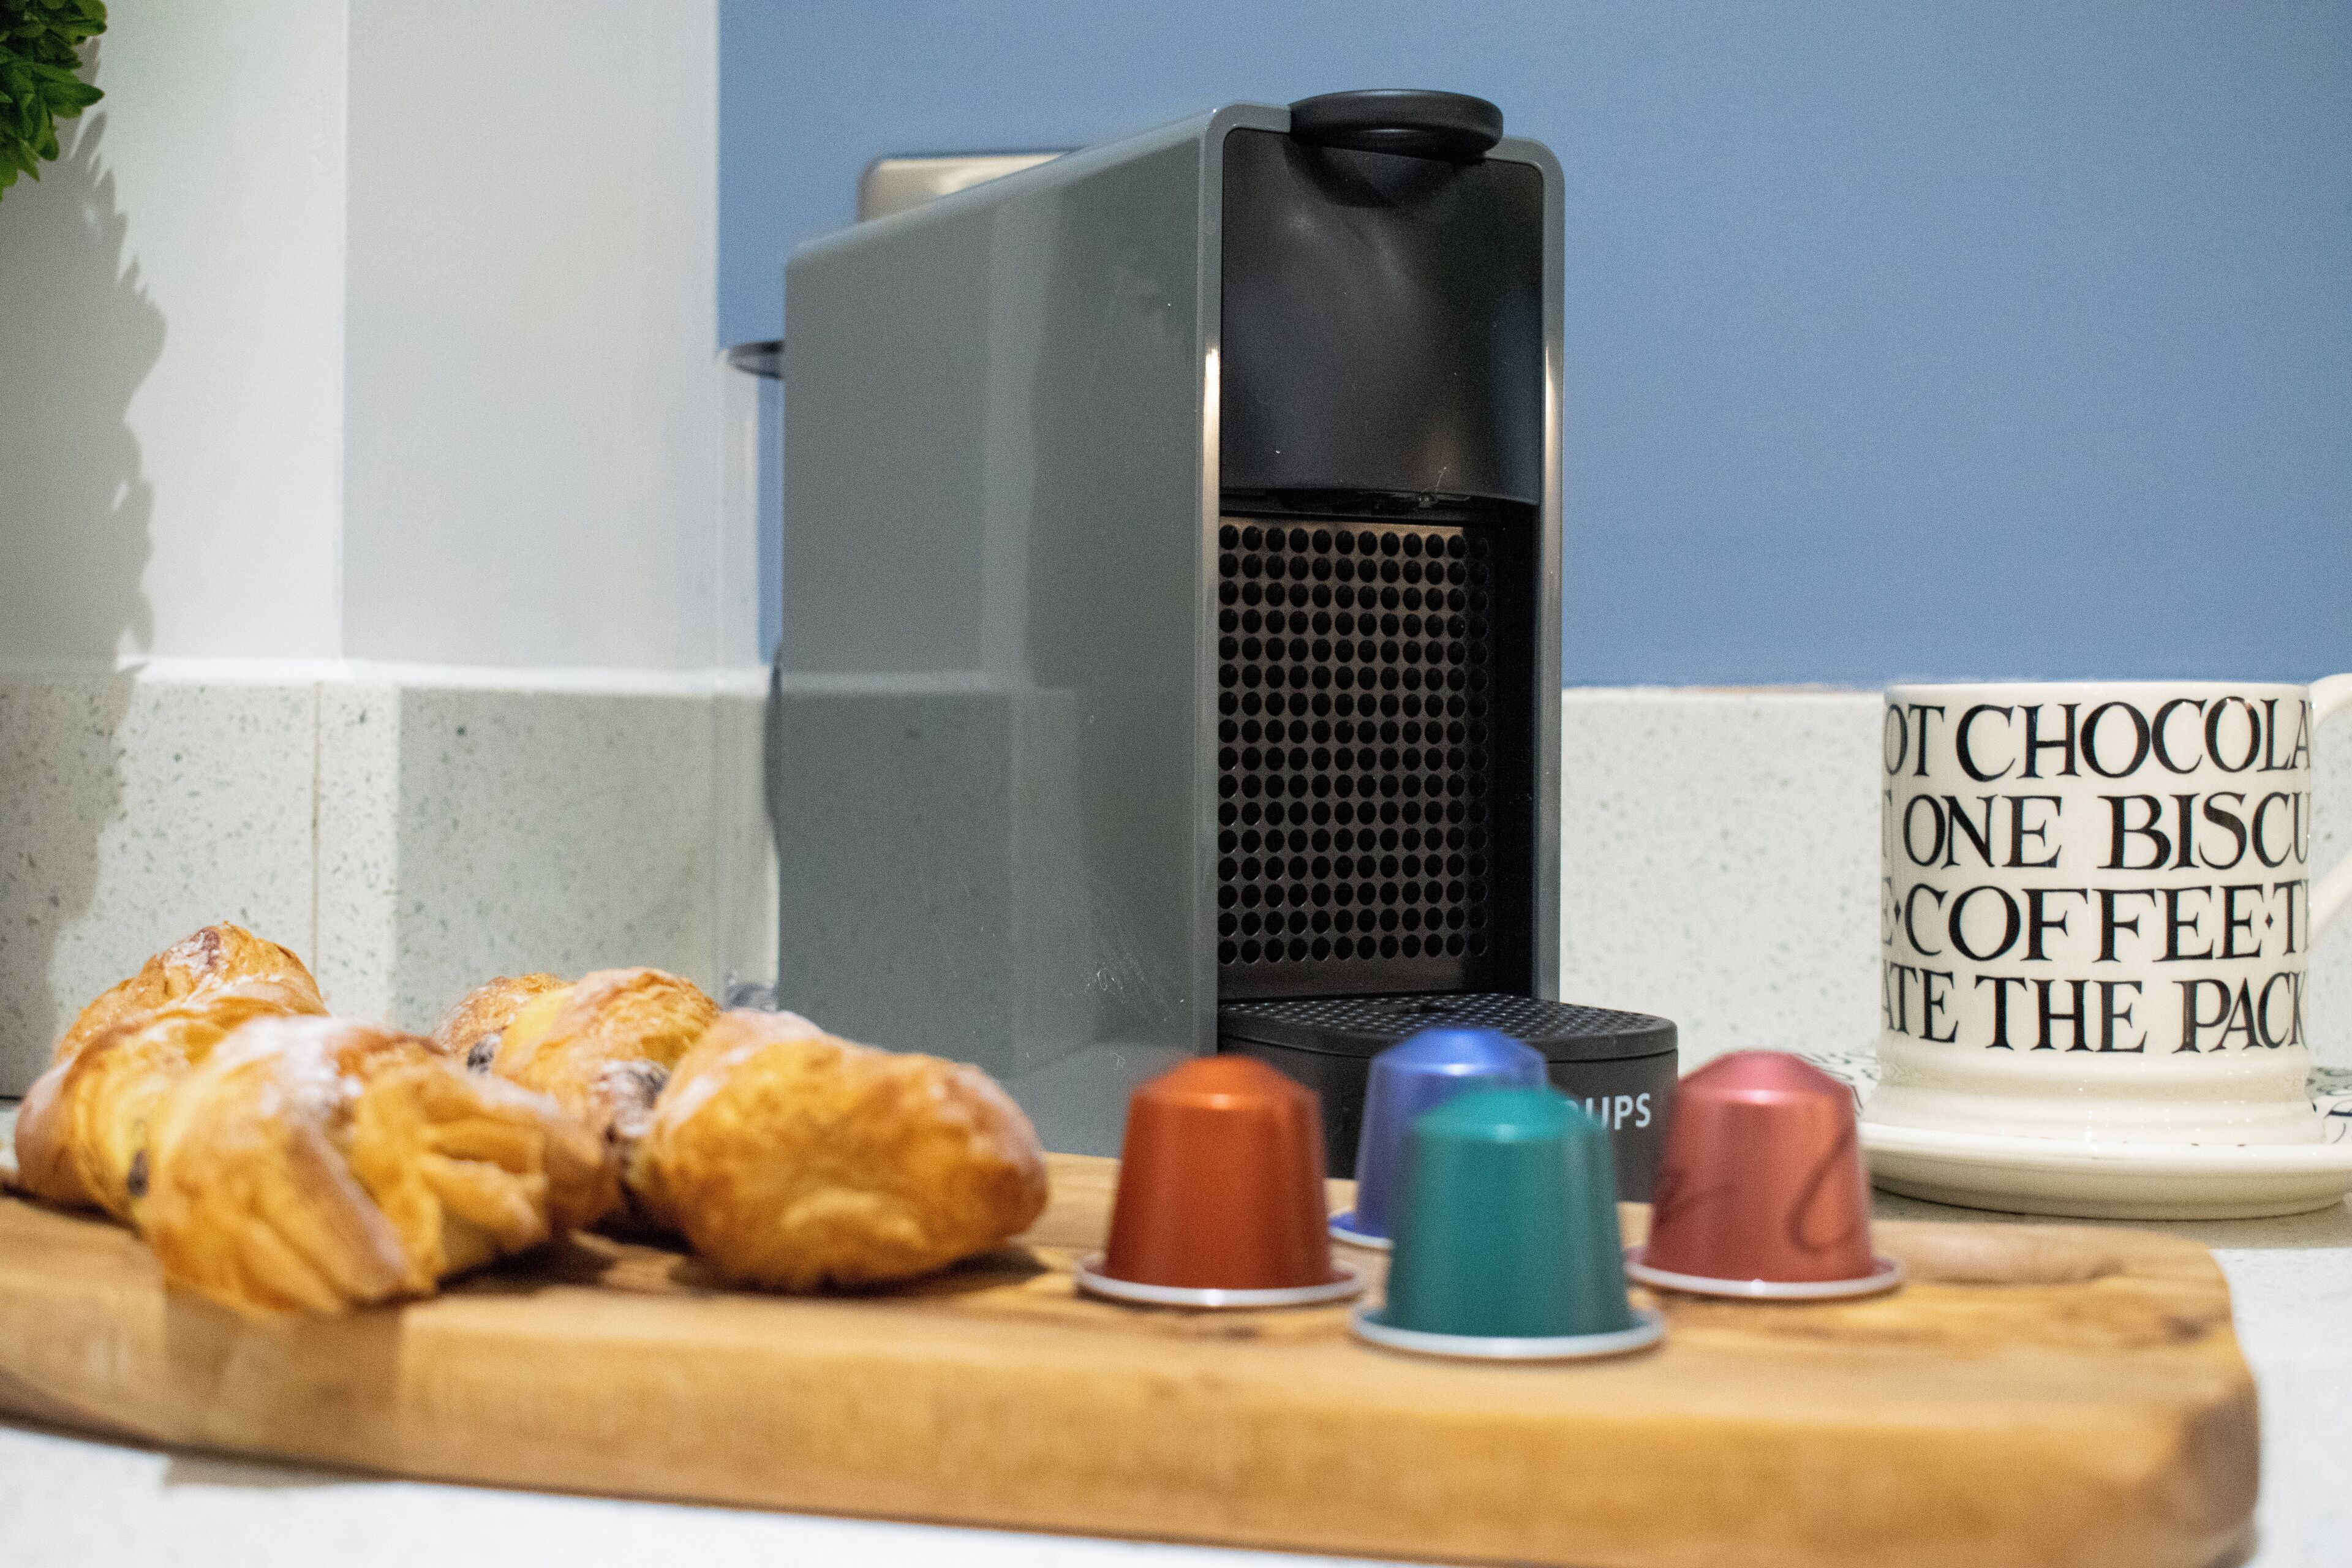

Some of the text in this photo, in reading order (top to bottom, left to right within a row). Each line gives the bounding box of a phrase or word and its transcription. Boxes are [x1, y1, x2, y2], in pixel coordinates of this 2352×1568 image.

[1902, 794, 2062, 870] ONE
[2097, 791, 2312, 870] BISCU
[1974, 974, 2147, 1053] THE
[2172, 970, 2309, 1054] PACK
